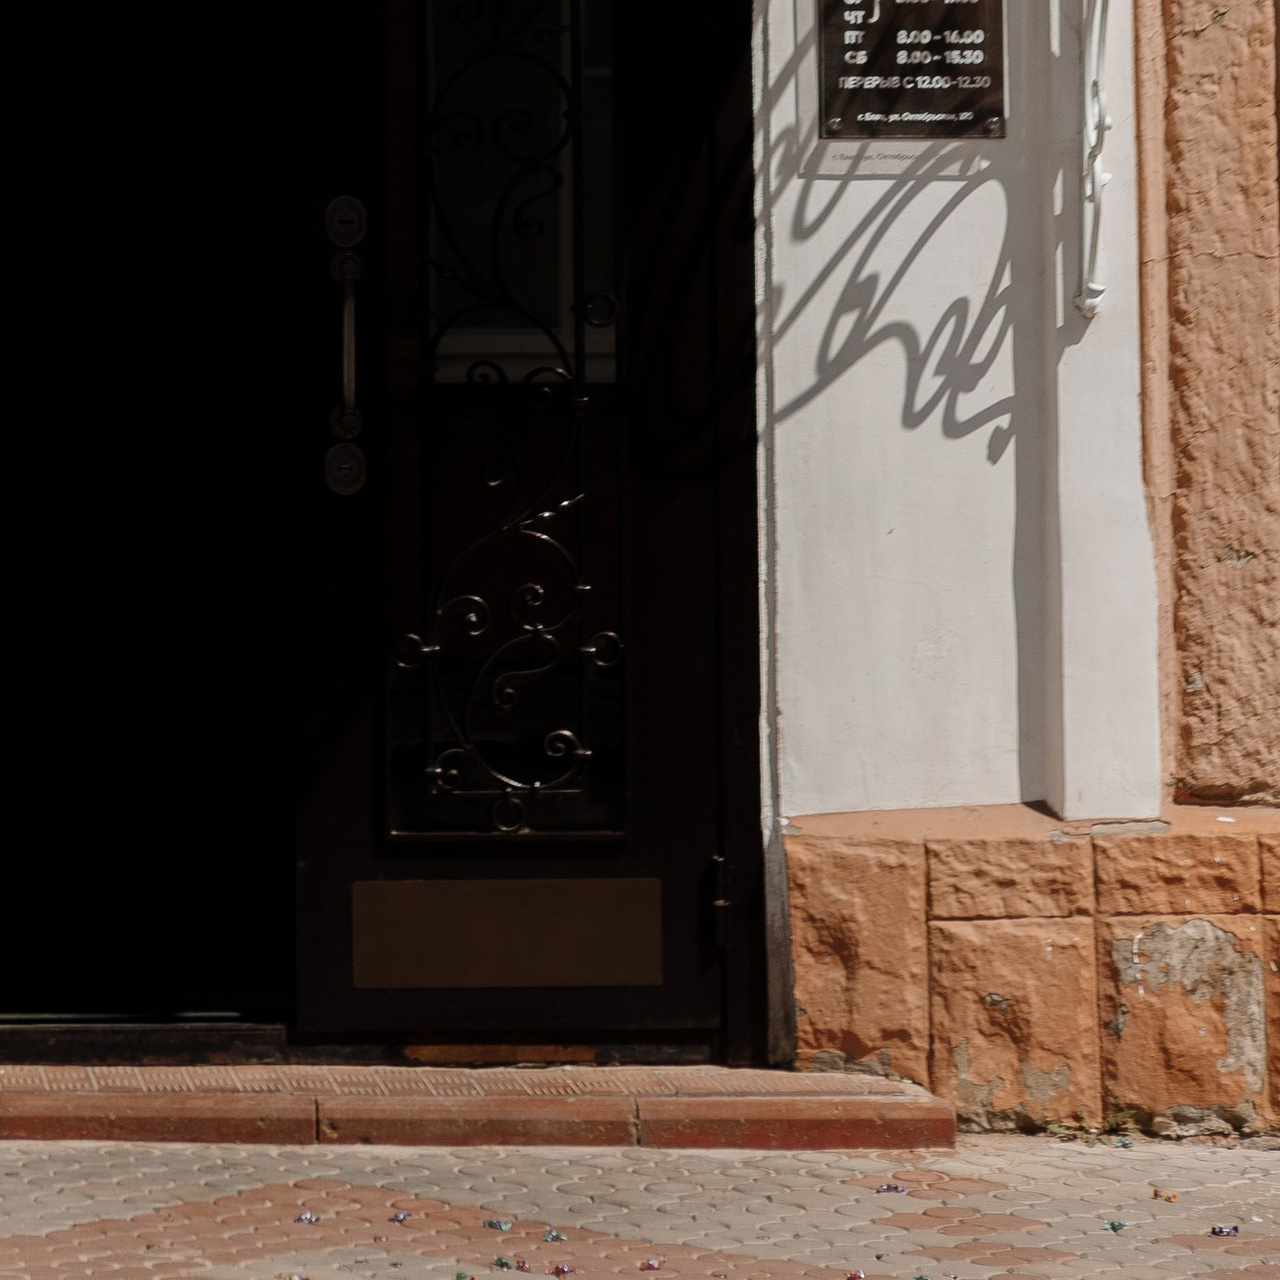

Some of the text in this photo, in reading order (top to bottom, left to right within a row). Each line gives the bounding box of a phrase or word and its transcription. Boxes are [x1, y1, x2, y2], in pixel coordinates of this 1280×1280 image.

[844, 10, 865, 24] ЧТ
[844, 30, 866, 44] ПТ
[844, 50, 868, 64] СБ
[838, 76, 901, 89] ПЕРЕРЫВ
[902, 76, 915, 89] С
